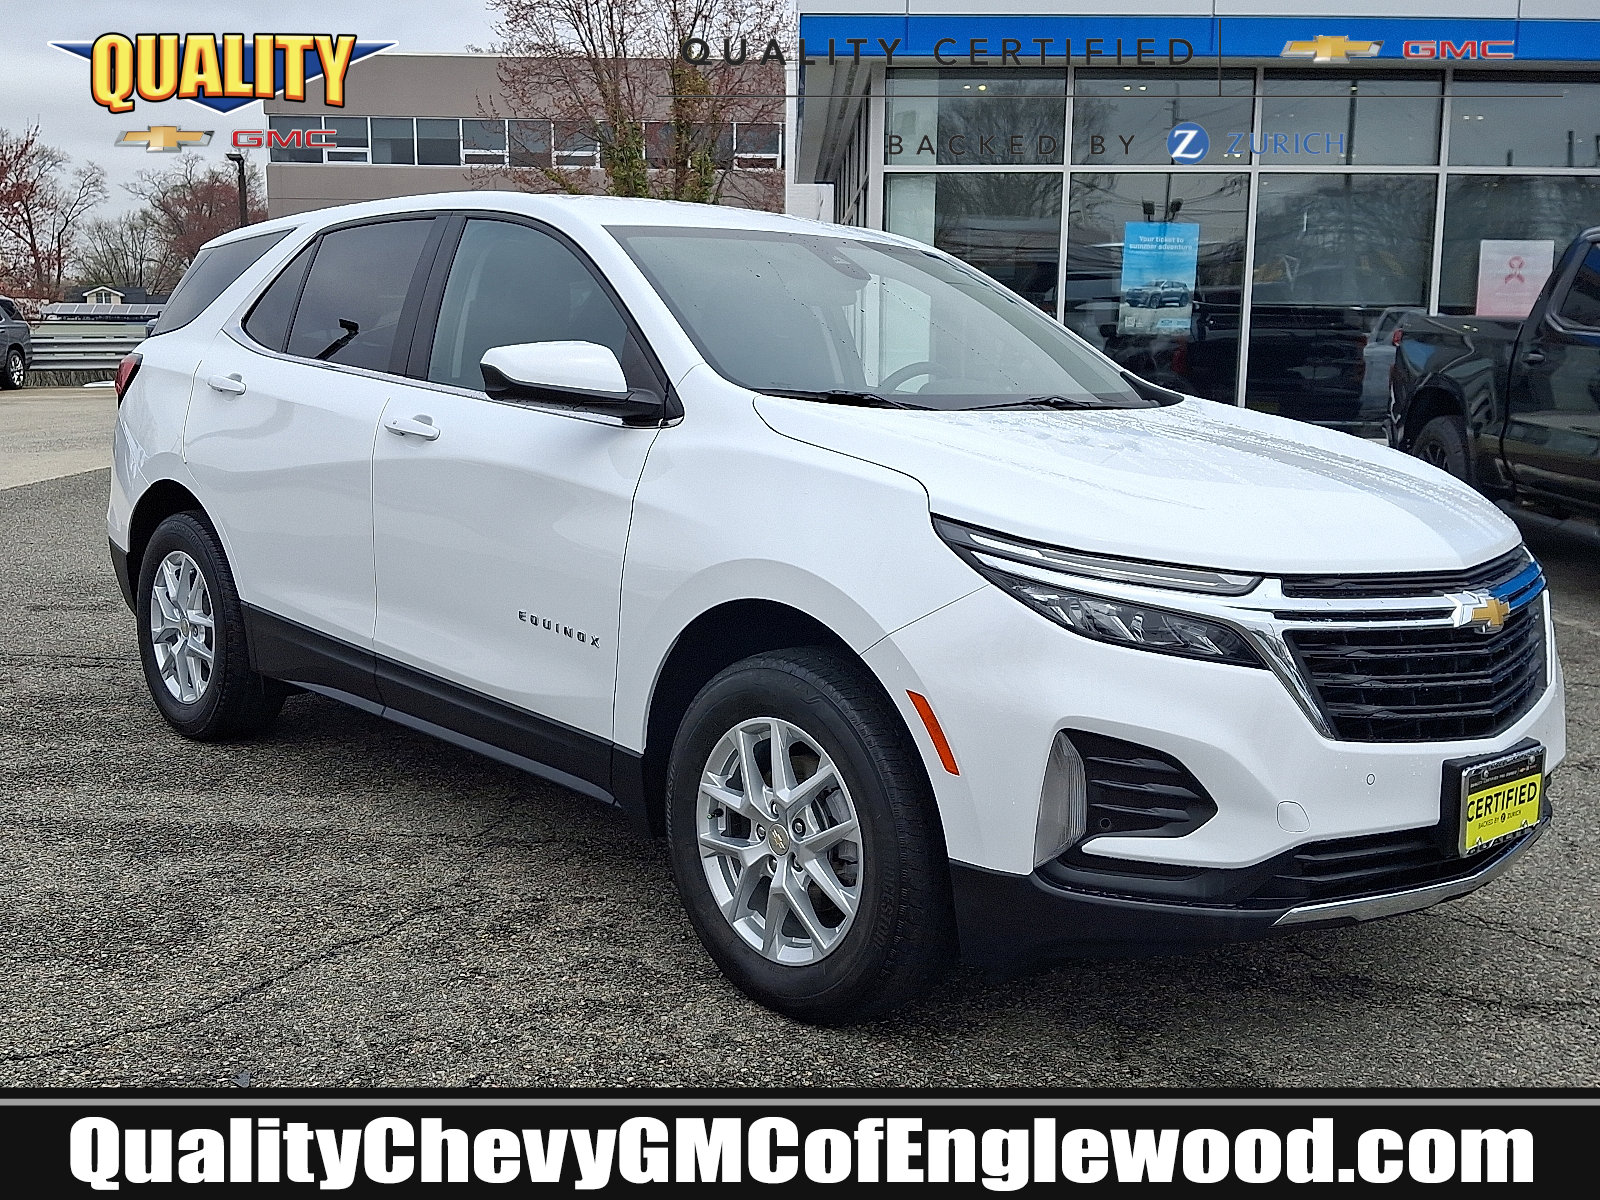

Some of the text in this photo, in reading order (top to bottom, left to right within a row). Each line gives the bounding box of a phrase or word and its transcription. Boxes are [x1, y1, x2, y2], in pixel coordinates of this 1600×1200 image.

[1138, 235, 1154, 243] Your
[518, 610, 600, 649] EQUINOX
[1466, 782, 1537, 822] CERTIFIED
